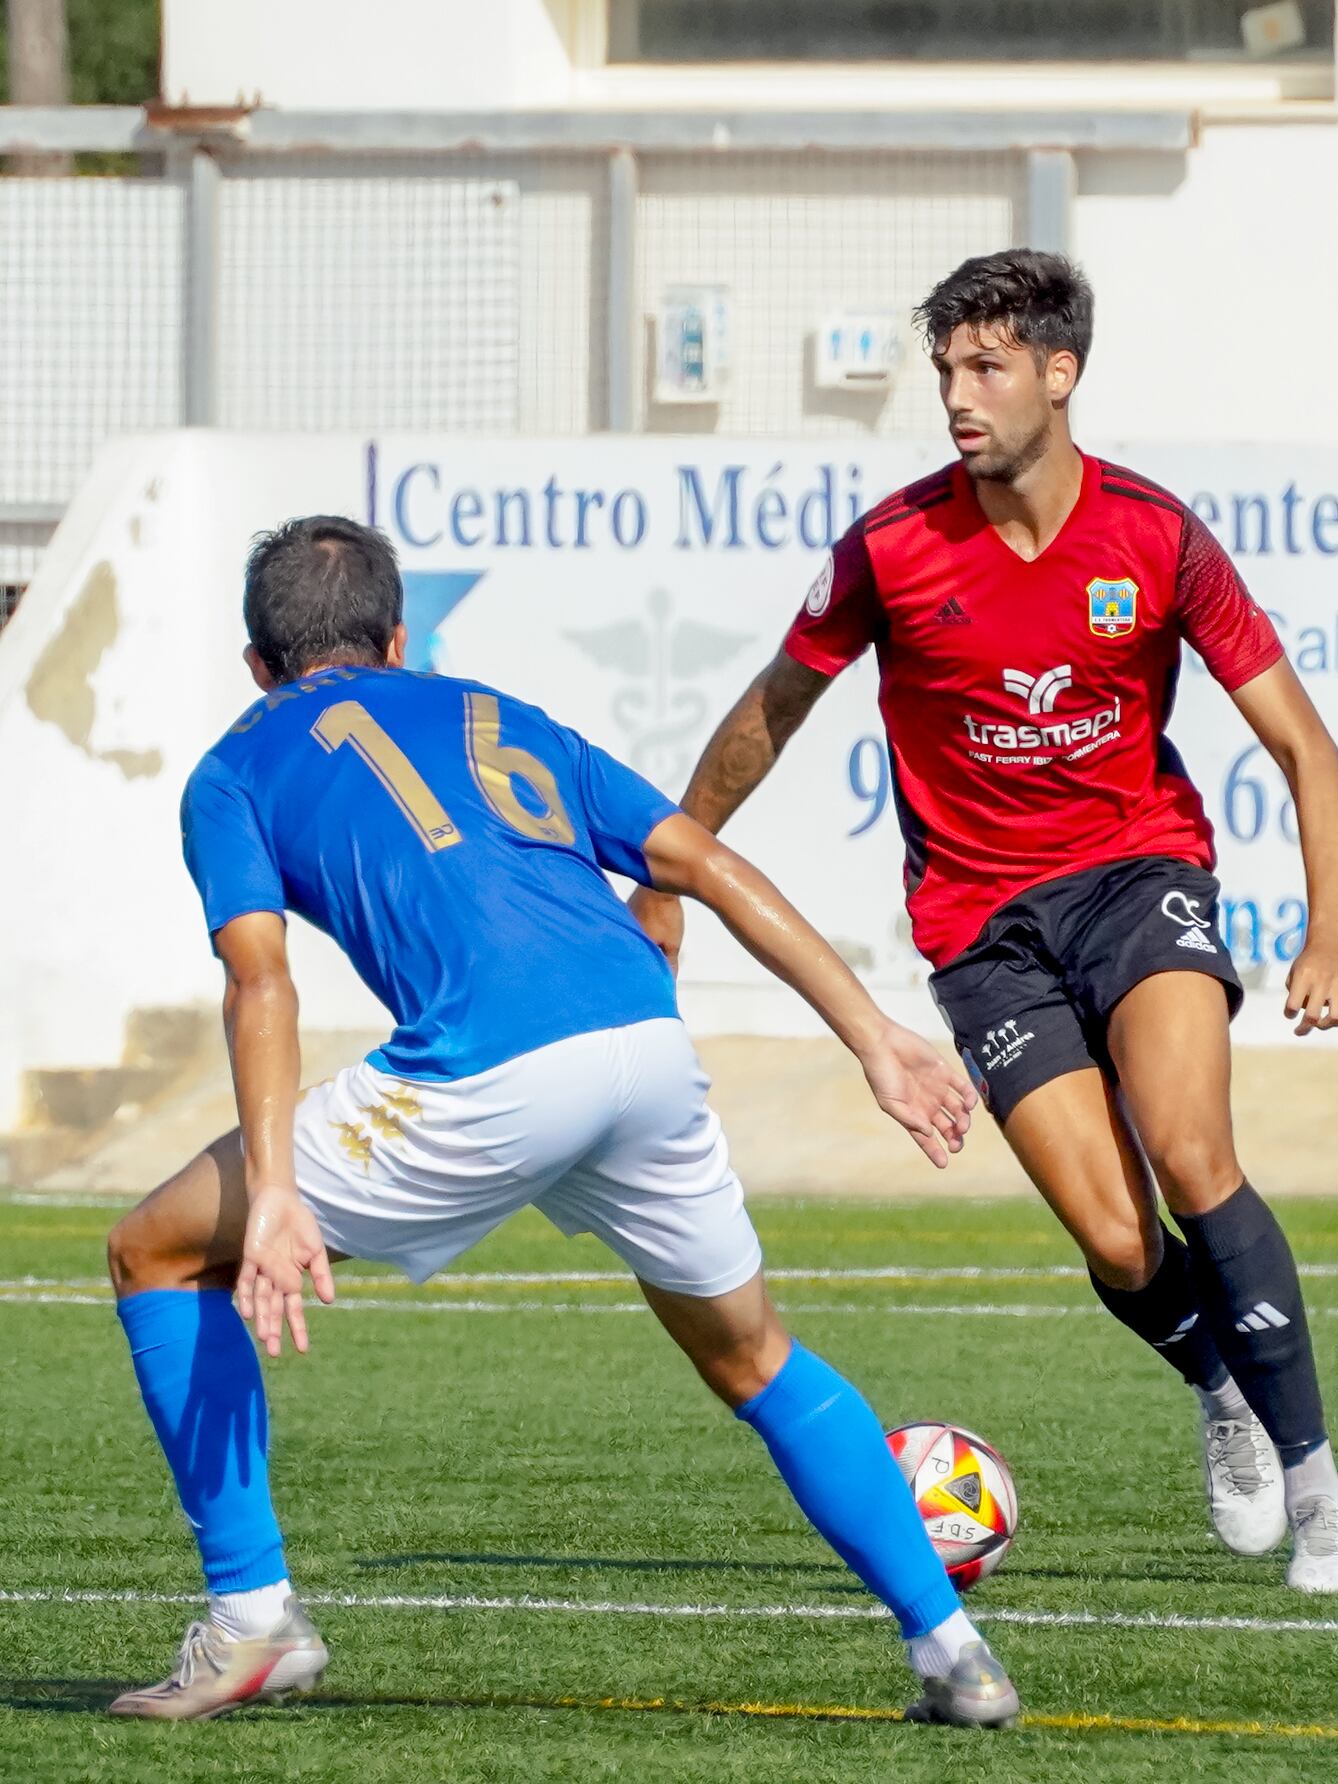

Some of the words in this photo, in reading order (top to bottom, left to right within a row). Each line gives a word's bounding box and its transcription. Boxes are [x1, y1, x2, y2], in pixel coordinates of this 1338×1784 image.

[391, 462, 647, 549] Centro
[963, 695, 1121, 749] trasmapi
[995, 755, 1030, 764] FERRY
[1061, 730, 1121, 762] ORMENTERA
[309, 691, 576, 854] 16
[1175, 940, 1218, 954] adidas
